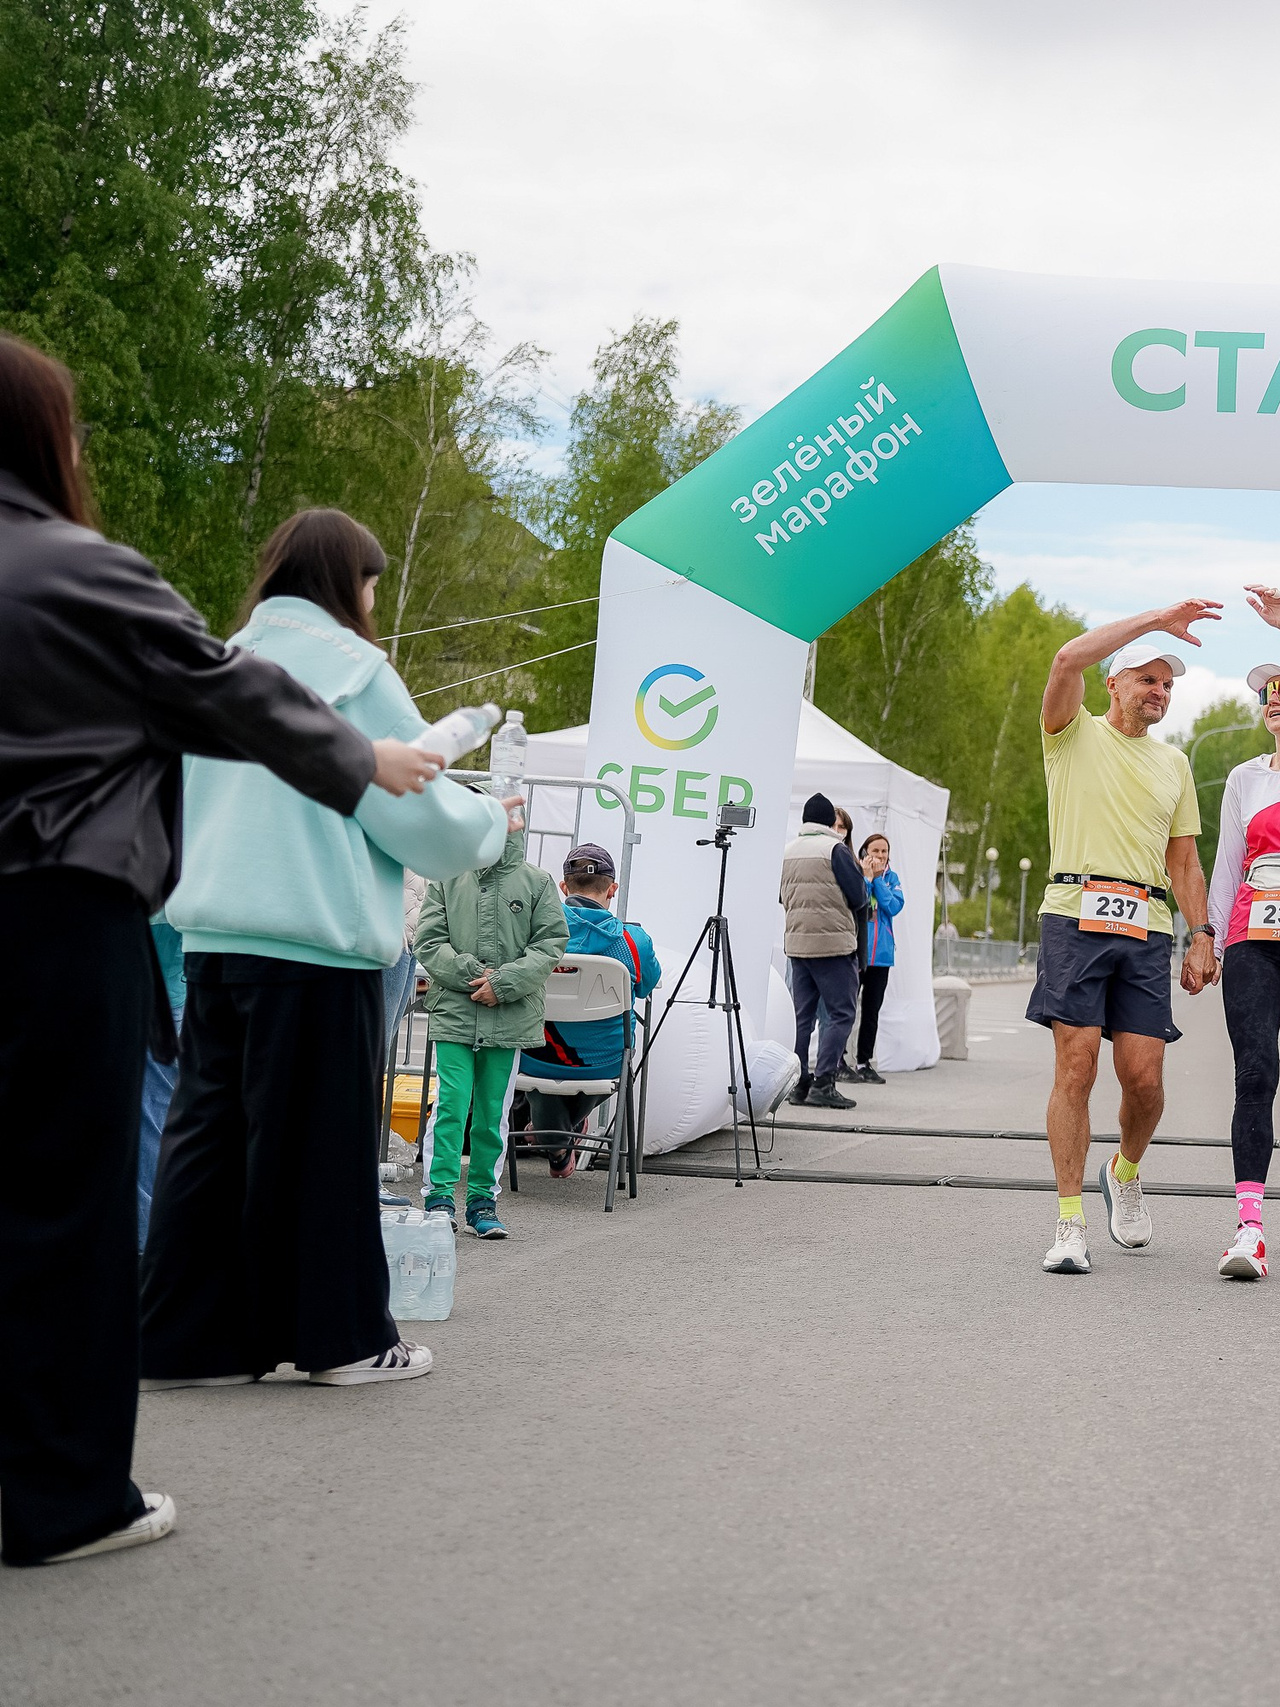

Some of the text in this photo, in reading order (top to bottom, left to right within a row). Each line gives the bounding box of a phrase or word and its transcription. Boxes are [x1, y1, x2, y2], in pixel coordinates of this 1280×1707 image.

[730, 375, 898, 524] зелёный
[753, 412, 924, 557] марафон
[595, 762, 754, 820] СБЕР
[1096, 896, 1138, 920] 237
